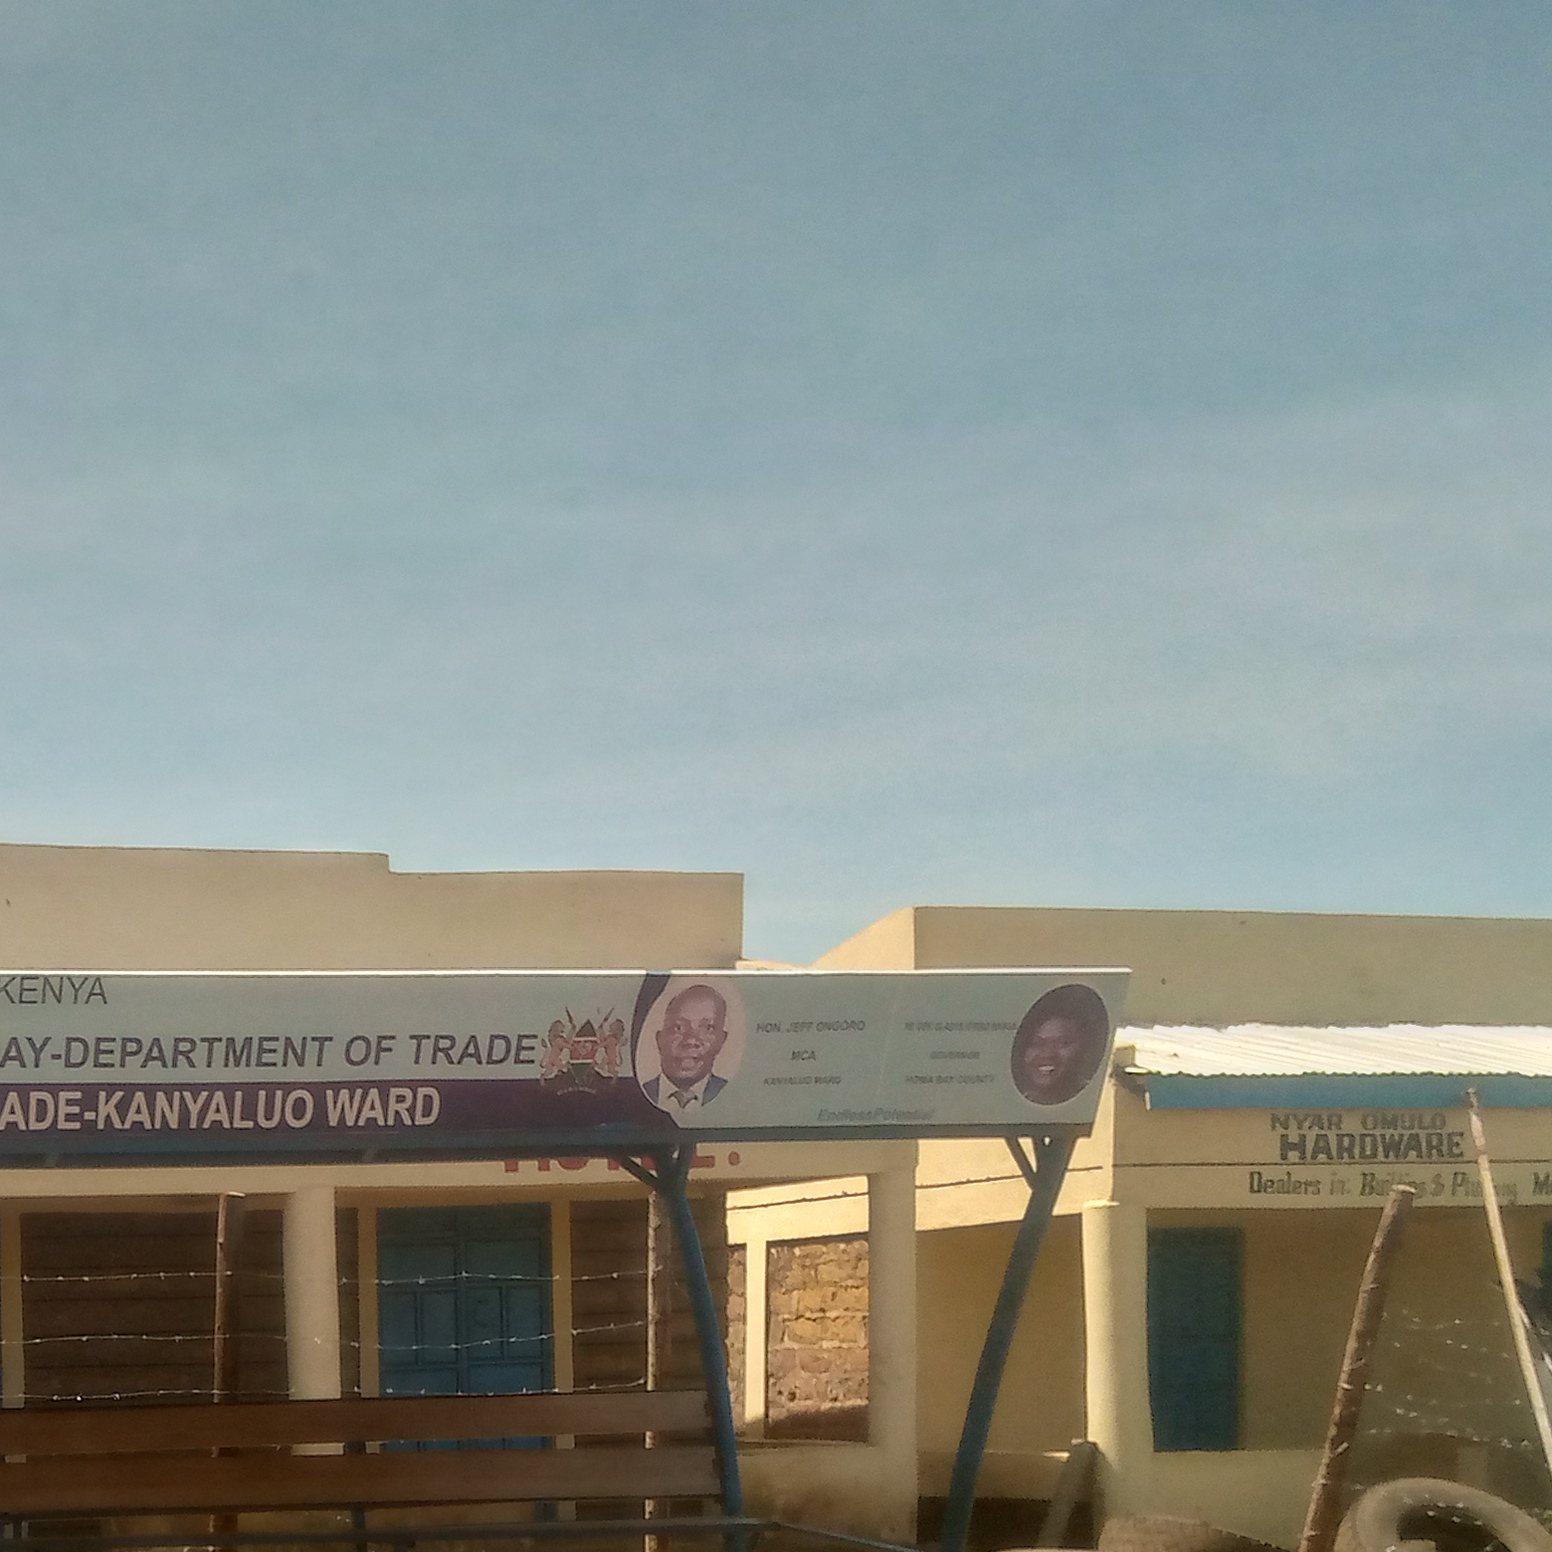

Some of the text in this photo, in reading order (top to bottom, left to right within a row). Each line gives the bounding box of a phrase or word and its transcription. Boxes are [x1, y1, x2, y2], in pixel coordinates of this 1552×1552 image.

[344, 1034, 396, 1068] OF
[409, 1033, 538, 1067] TRADE
[325, 1085, 442, 1128] WARD
[1270, 1112, 1343, 1131] NYAR
[1279, 1131, 1465, 1161] HARDWARE
[1249, 1171, 1321, 1196] Dealers
